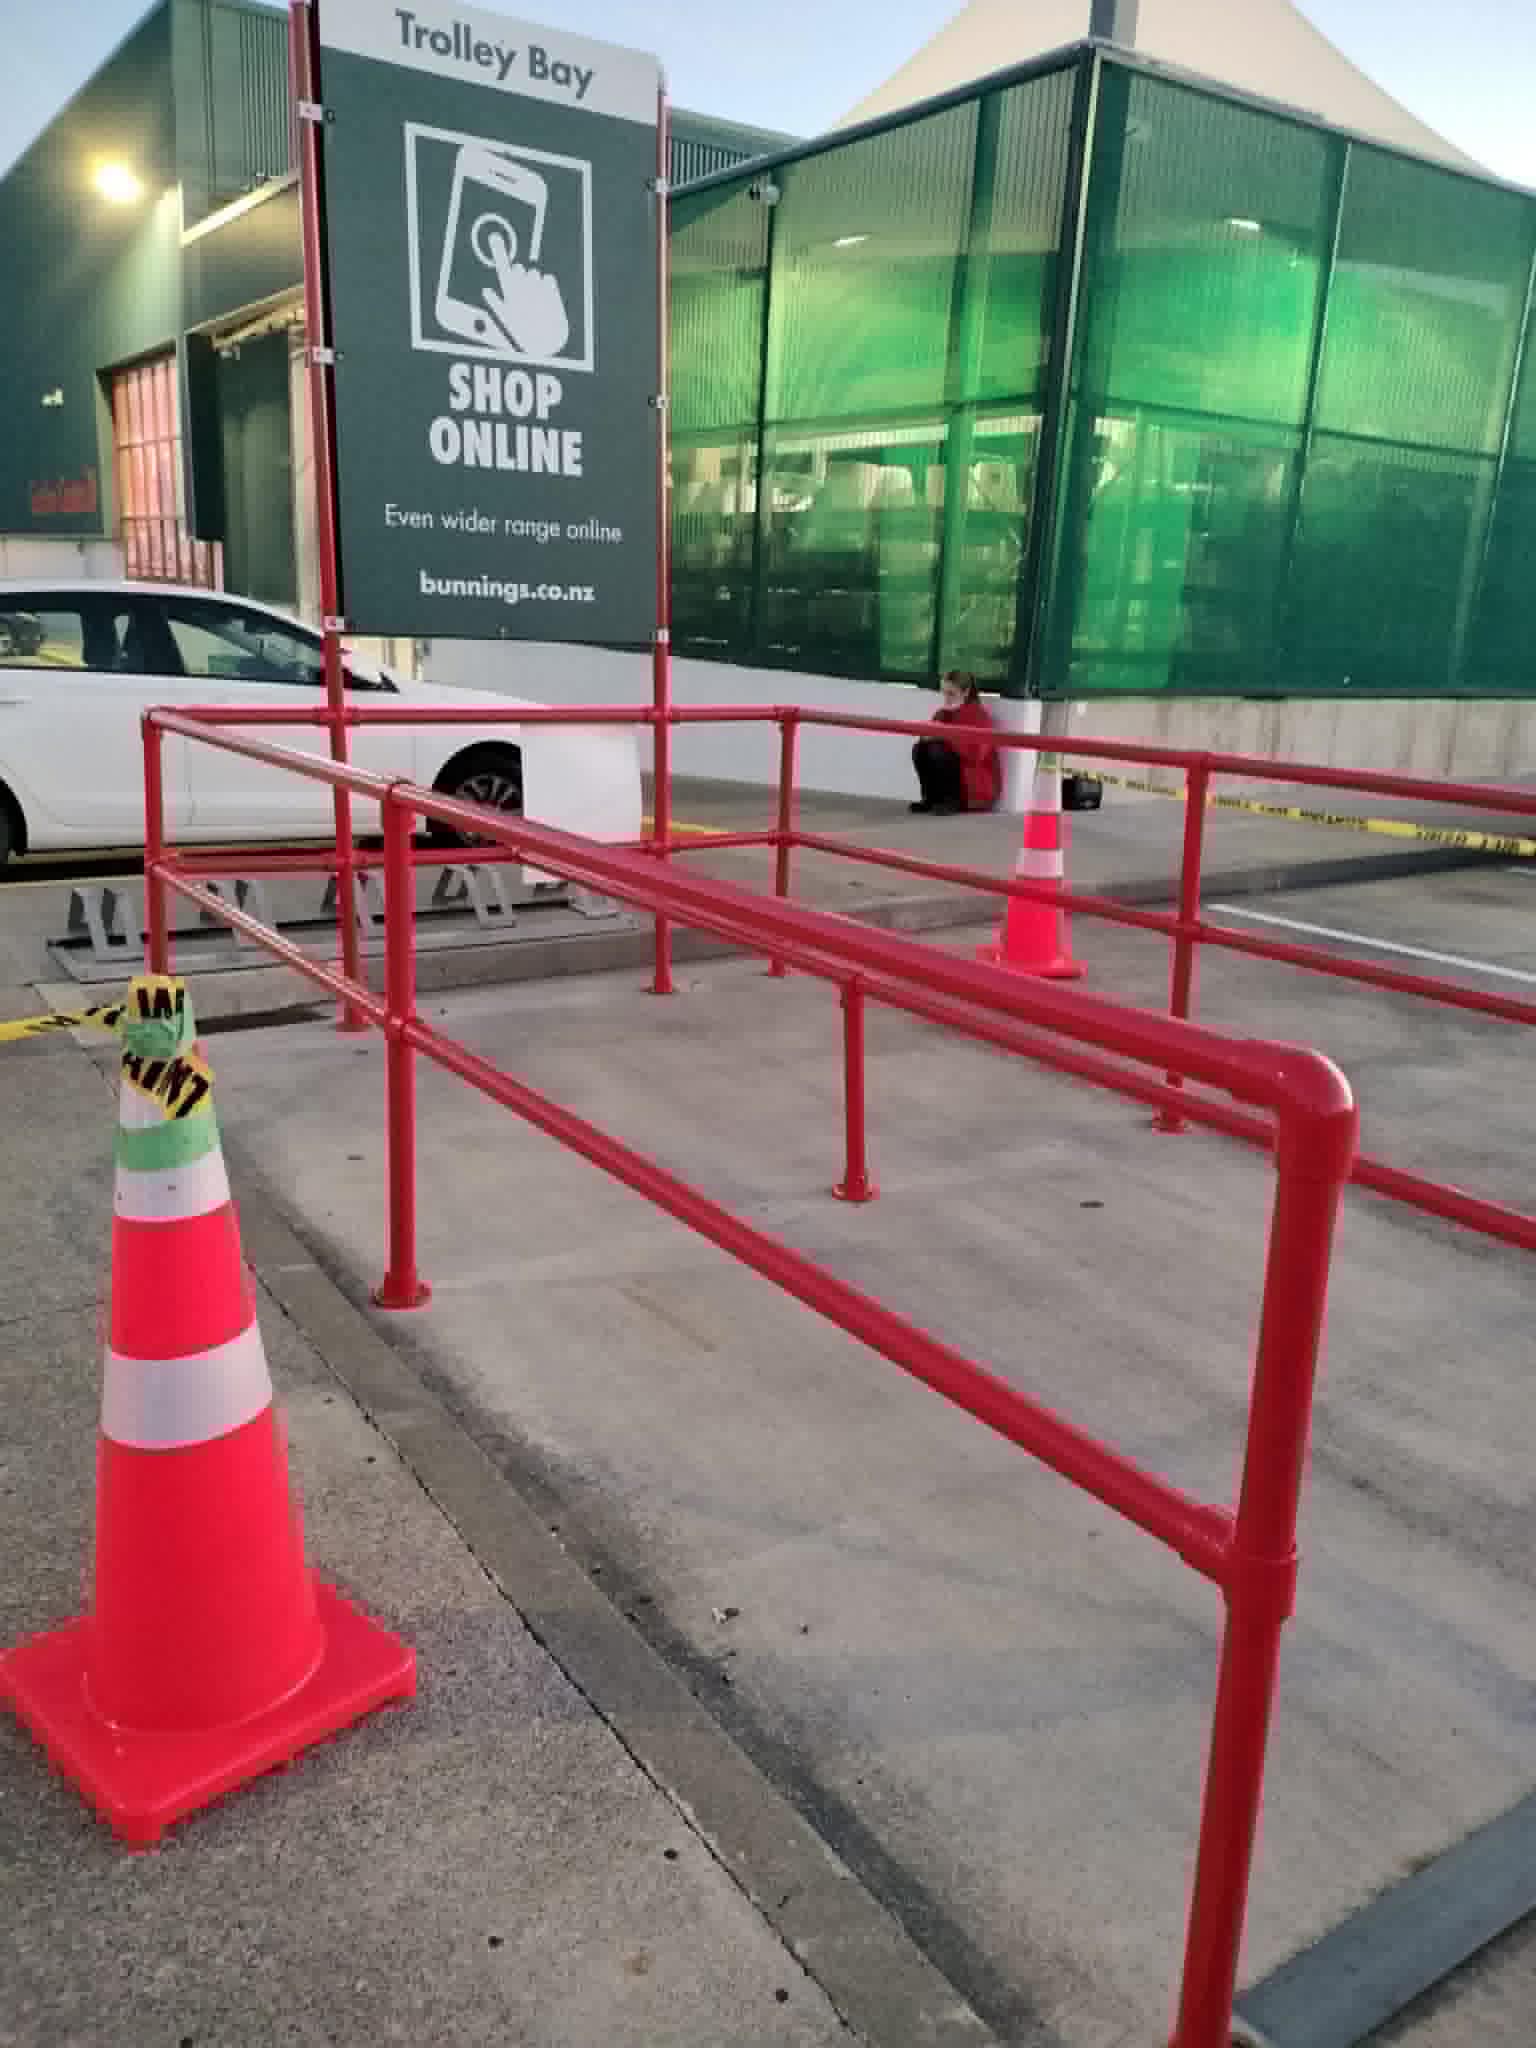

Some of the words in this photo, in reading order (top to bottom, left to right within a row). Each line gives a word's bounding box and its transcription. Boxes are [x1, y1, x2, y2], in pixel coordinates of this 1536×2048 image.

[395, 8, 516, 80] Trolley
[528, 45, 594, 98] Bay
[449, 362, 563, 419] SHOP
[429, 417, 584, 478] ONLINE
[384, 503, 434, 530] Even
[440, 509, 497, 534] wider
[504, 517, 561, 543] range
[567, 518, 623, 544] online
[419, 570, 596, 604] bunnings.co.nz
